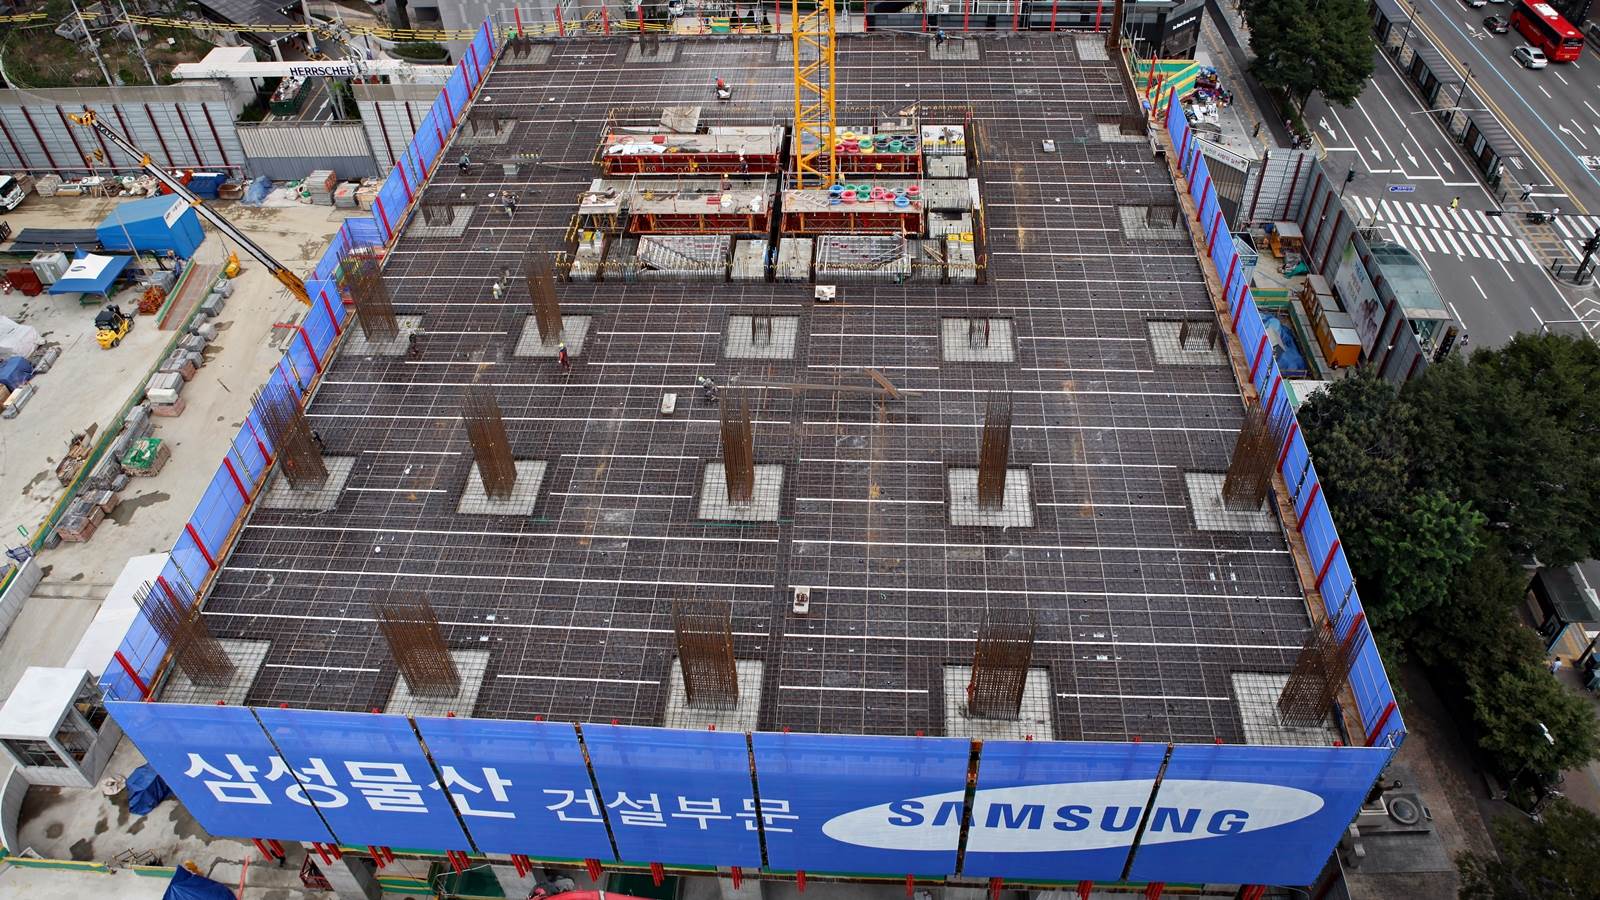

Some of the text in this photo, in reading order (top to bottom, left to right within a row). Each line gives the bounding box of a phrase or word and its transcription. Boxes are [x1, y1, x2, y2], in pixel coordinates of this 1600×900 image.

[290, 66, 354, 76] HERRSCHER
[184, 753, 799, 832] 삼성물산 건설부문
[888, 801, 1249, 835] SAMSUNG
